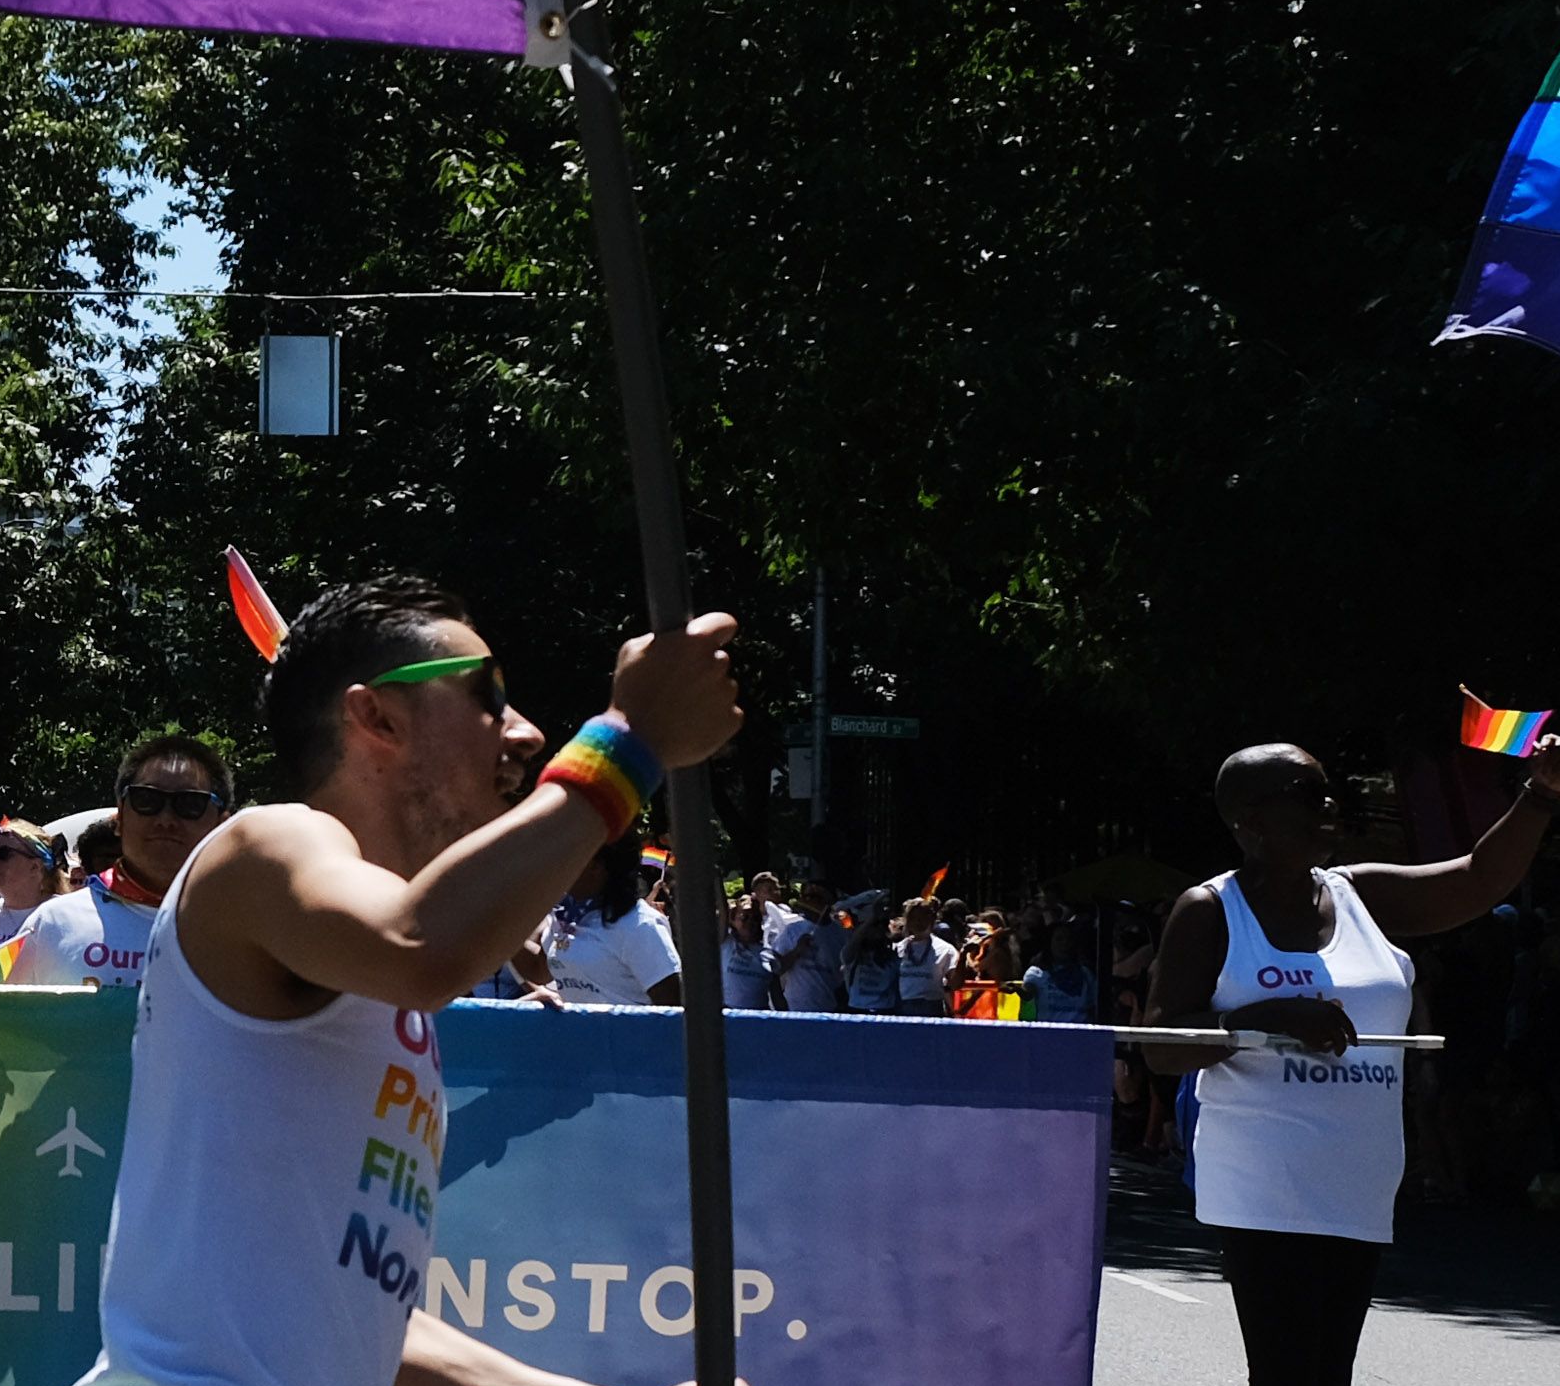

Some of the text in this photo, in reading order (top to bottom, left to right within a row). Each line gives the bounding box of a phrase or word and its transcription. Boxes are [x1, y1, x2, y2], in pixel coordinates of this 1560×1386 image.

[831, 716, 888, 734] Blanchard
[83, 942, 145, 970] Our
[1257, 966, 1314, 989] Our
[1283, 1058, 1397, 1089] Nonstop.
[374, 1063, 441, 1169] Pri
[358, 1137, 432, 1231] Flie
[425, 1256, 808, 1341] NSTOP.
